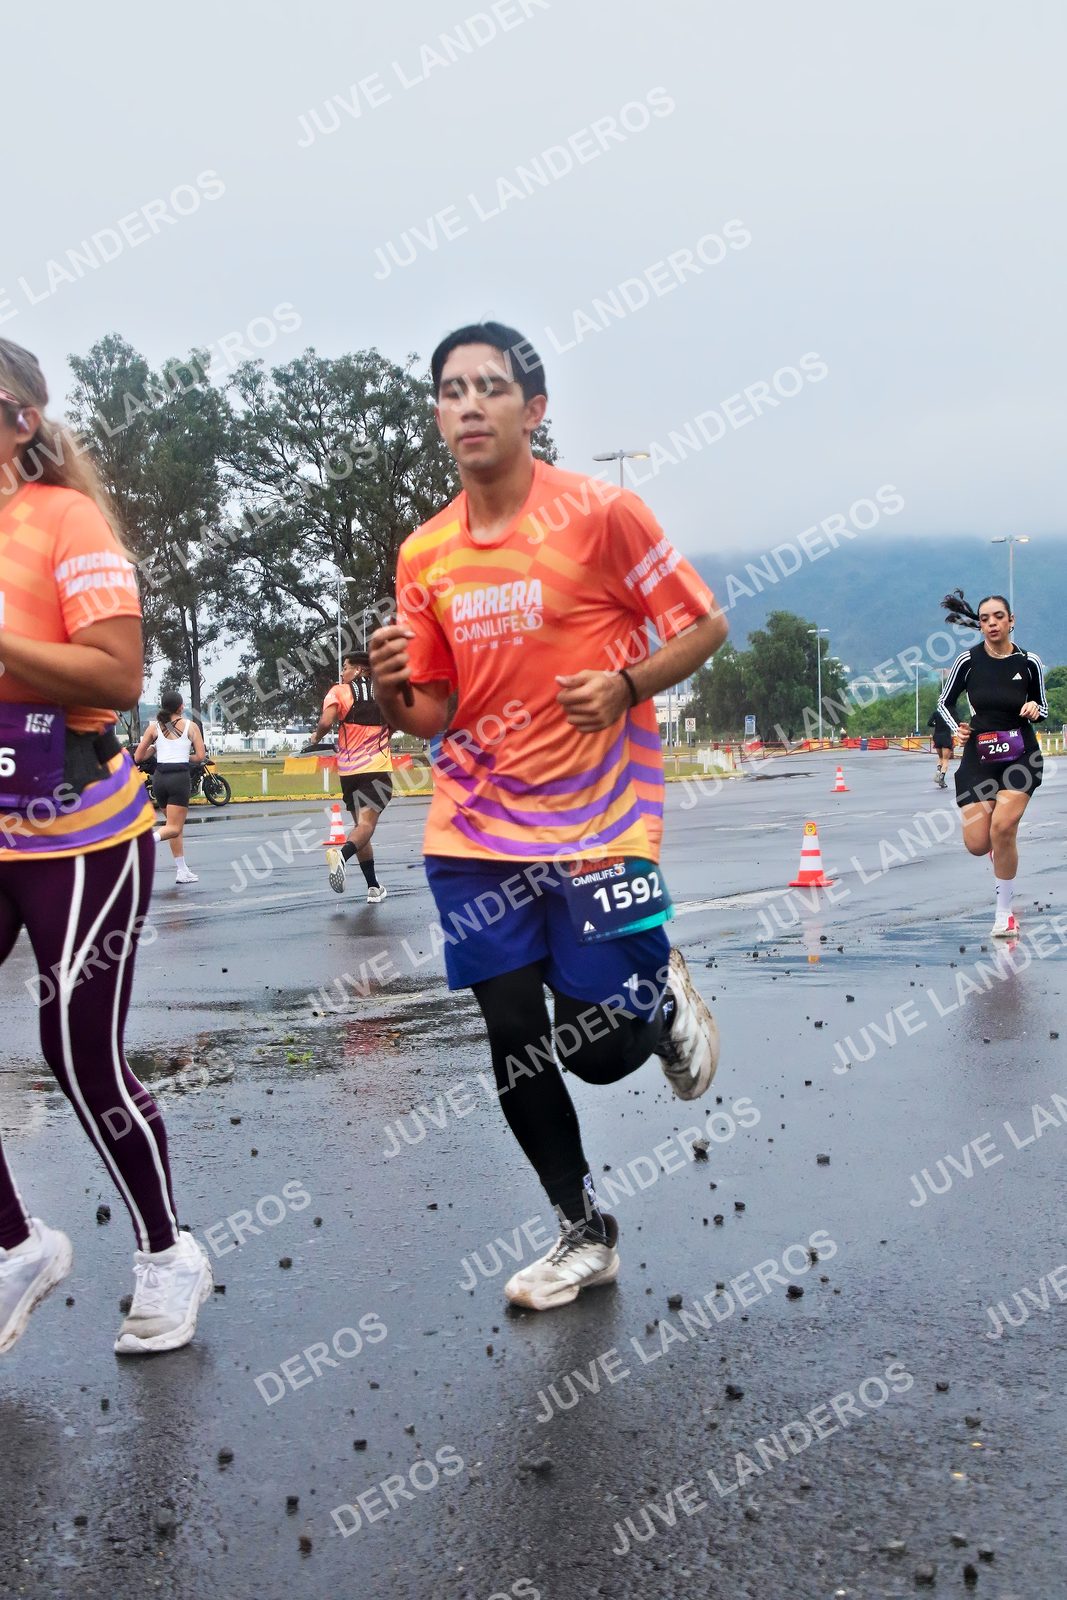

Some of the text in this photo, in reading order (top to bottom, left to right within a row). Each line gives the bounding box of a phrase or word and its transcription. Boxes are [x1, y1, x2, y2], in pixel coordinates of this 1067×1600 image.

[452, 579, 542, 622] CARRERA
[454, 616, 520, 643] OMNILIFE
[0, 747, 16, 777] 6
[988, 742, 1010, 754] 249
[572, 868, 614, 887] OMNILIFE
[593, 871, 663, 913] 1592
